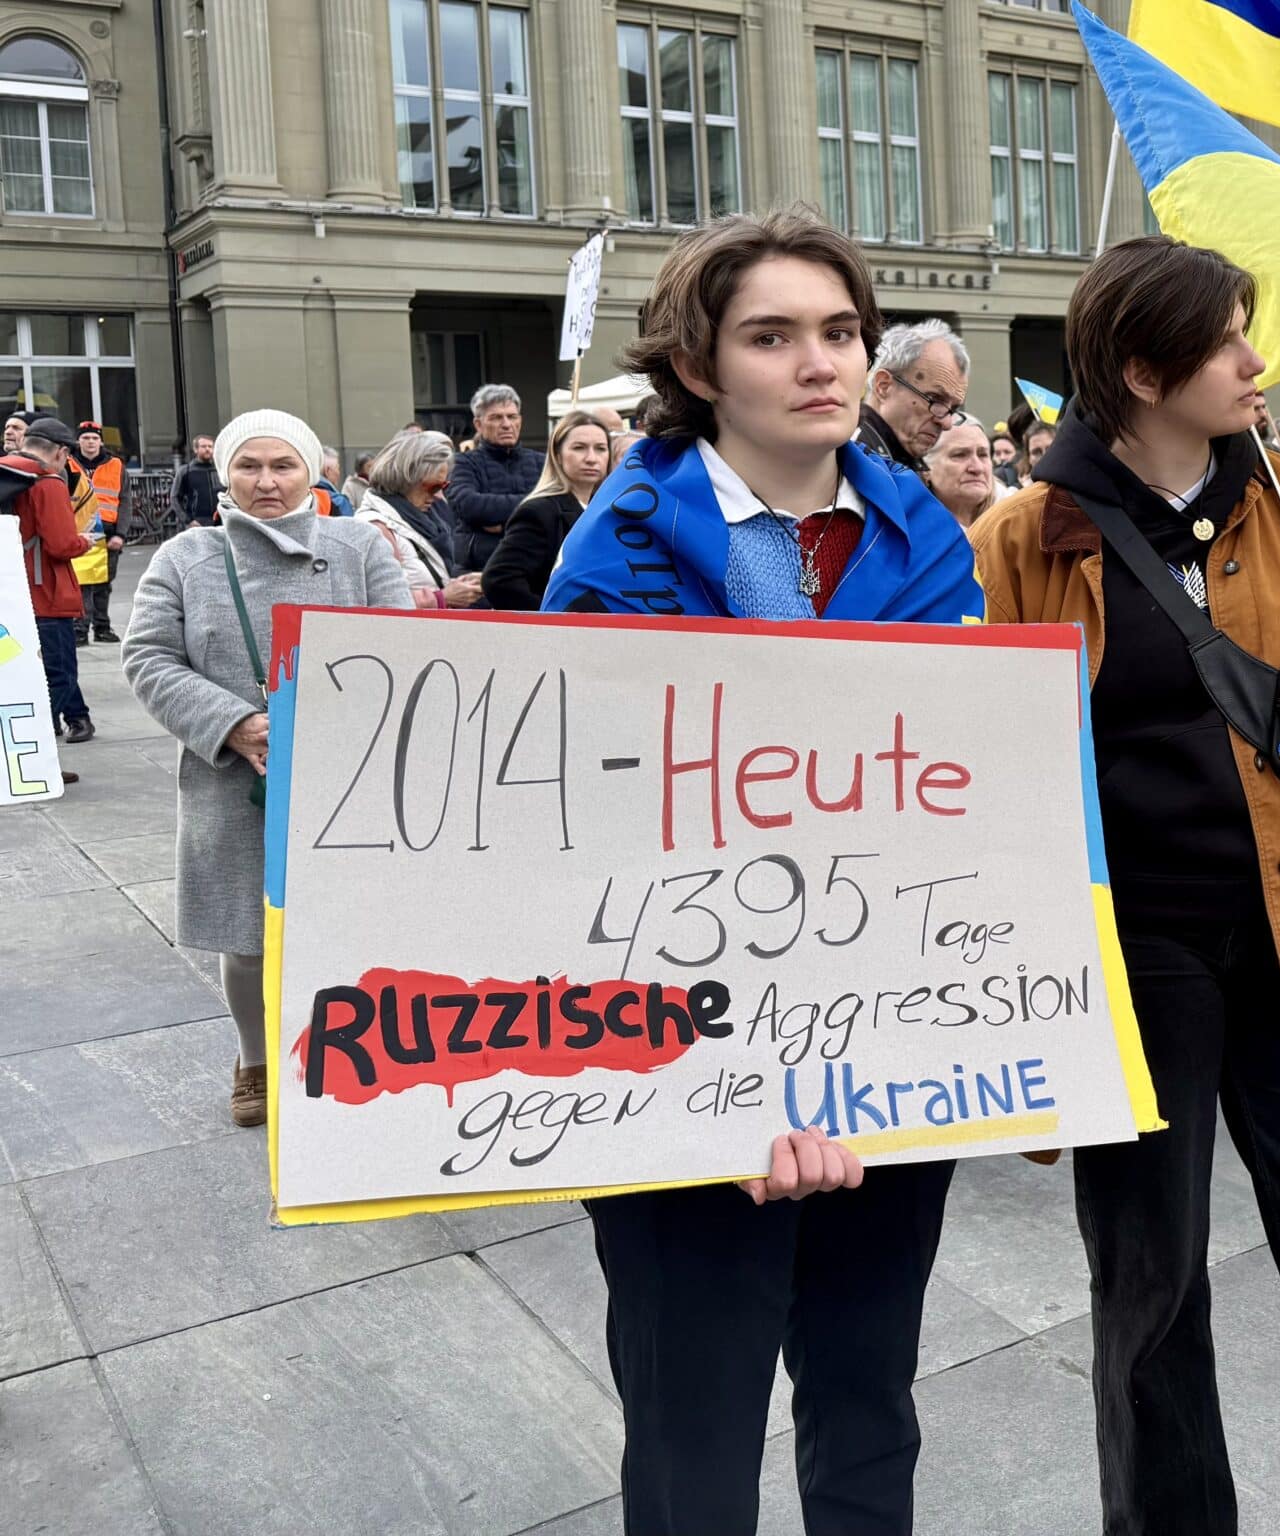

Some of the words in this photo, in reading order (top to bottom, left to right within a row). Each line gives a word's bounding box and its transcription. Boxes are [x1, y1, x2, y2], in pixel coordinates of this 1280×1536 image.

[312, 654, 575, 851] 2014
[662, 682, 972, 852] Heute
[586, 853, 880, 981] 4395
[895, 871, 1015, 964] Tage
[686, 1067, 764, 1117] die
